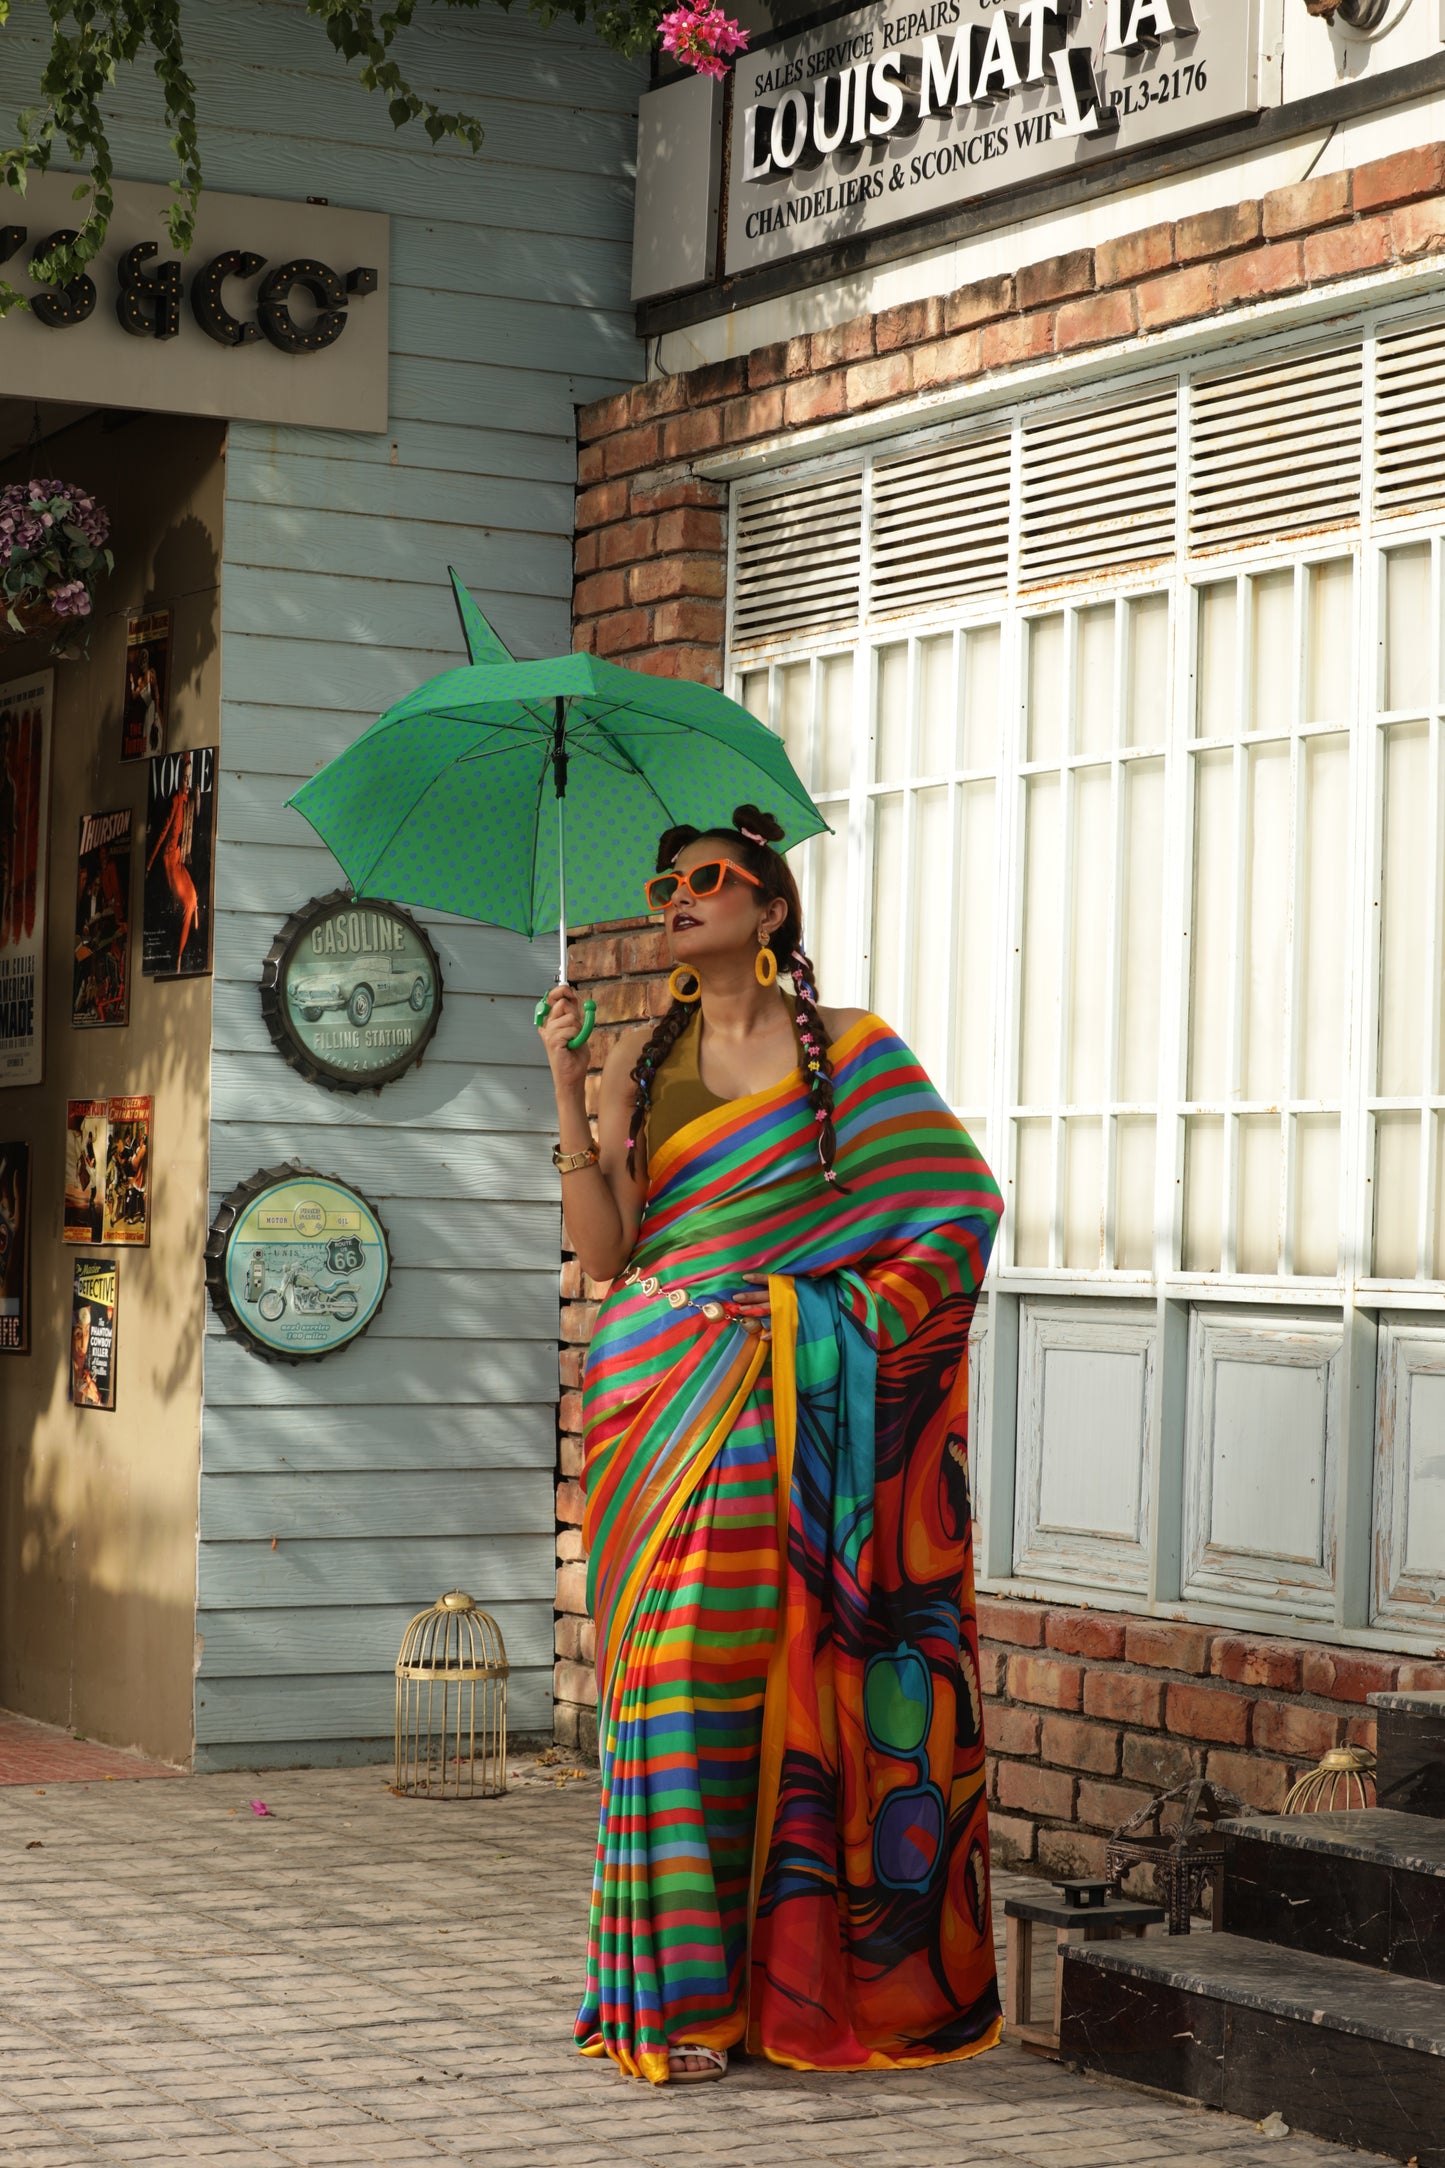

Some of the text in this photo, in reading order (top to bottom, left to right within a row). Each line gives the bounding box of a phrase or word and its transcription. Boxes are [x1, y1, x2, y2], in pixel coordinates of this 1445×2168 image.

[754, 0, 960, 98] SALES SERVICE REPAIRS
[741, 50, 904, 184] LOUIS
[744, 169, 885, 239] CHANDELIERS
[888, 163, 905, 192] &
[909, 126, 1009, 186] SCONCES
[1109, 60, 1207, 116] PL3-2176
[79, 809, 132, 857] THURSTON
[311, 912, 406, 955] GASOLINE
[314, 1028, 412, 1050] FILLING STATION
[109, 1106, 150, 1121] CHINATOWN
[122, 1097, 141, 1108] QUEEN
[334, 1240, 353, 1248] ROUTE
[334, 1250, 358, 1270] 66
[79, 1276, 115, 1303] DETECTIVE
[90, 1326, 113, 1338] PHANTOM
[90, 1336, 112, 1348] COWBOY
